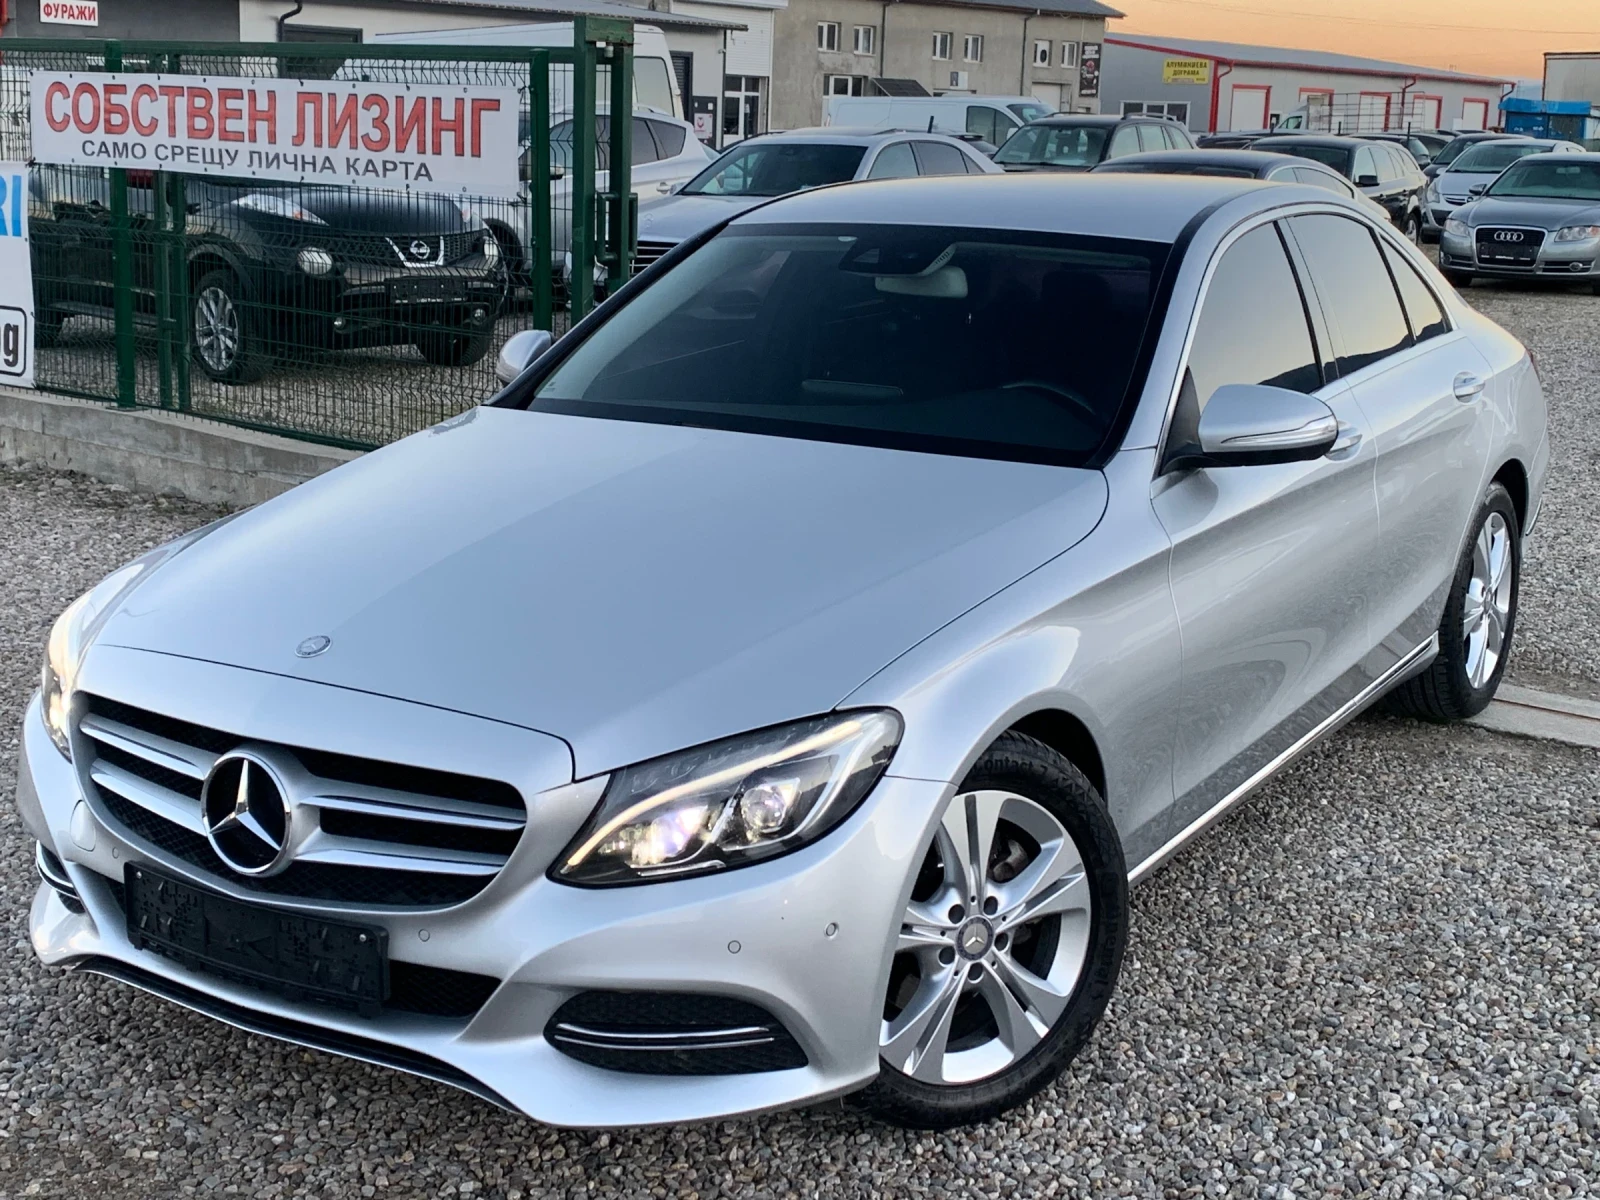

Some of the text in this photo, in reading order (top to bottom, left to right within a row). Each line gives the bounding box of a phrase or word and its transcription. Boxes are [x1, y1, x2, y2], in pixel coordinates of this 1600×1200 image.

[43, 2, 96, 21] ФУРАЖИ
[45, 81, 501, 158] СОБСТВЕН ЛИЗИНГ
[81, 139, 433, 182] САМО СРЕЩУ ЛИЧНА КАРТА
